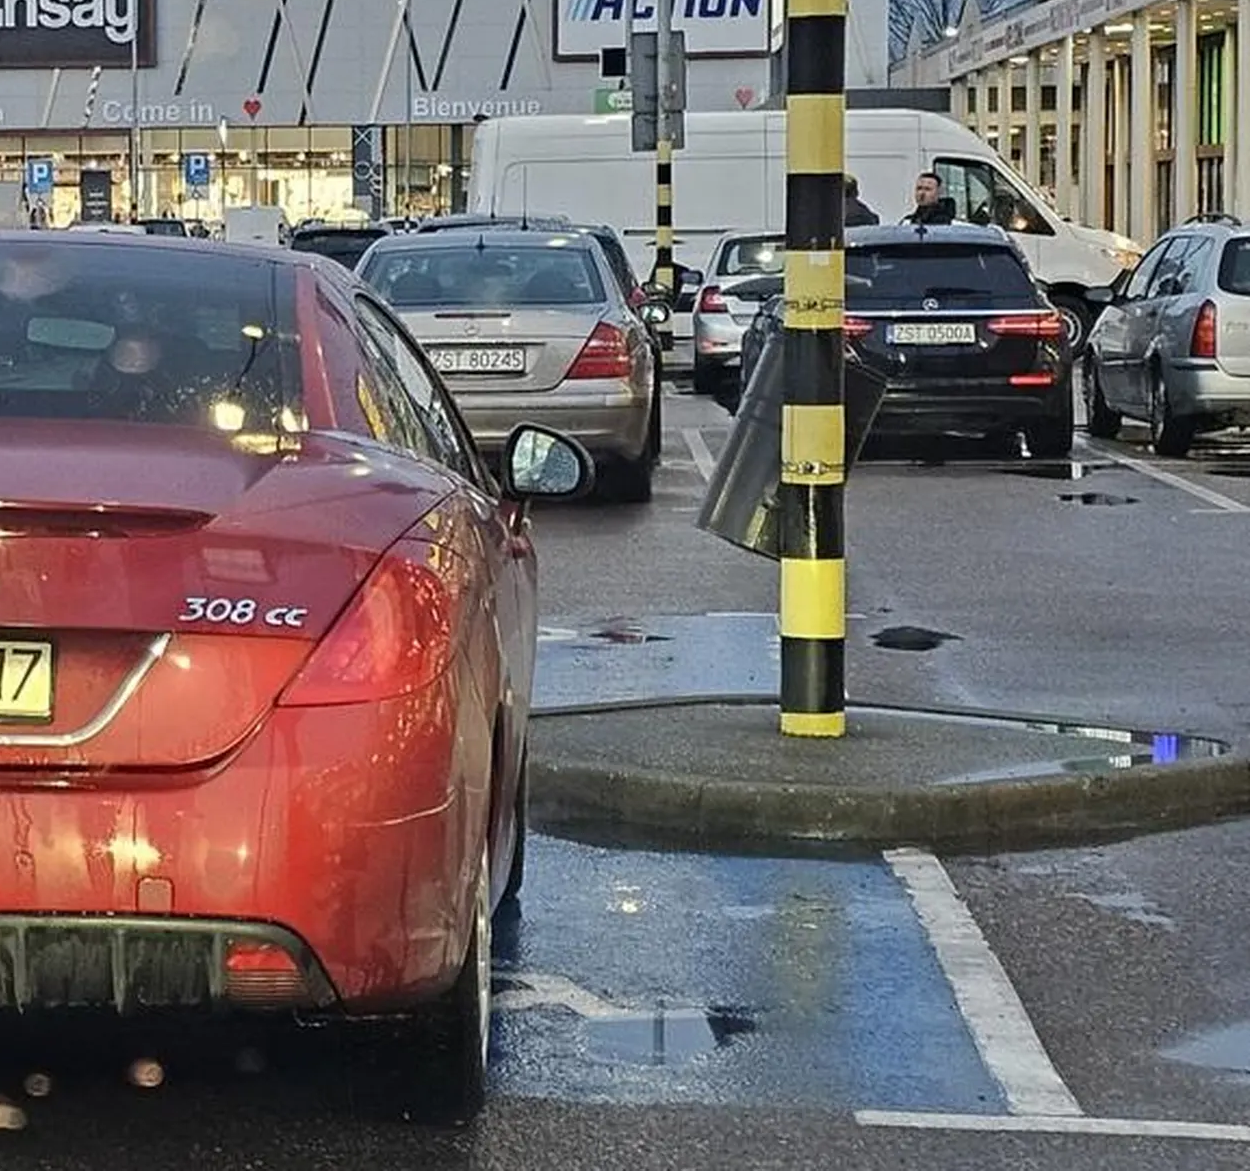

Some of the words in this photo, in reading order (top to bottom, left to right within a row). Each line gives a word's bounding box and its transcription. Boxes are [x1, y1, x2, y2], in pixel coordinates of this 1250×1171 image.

[102, 100, 180, 123] Come
[190, 97, 214, 123] in
[412, 96, 541, 117] Bienvenue
[33, 164, 49, 184] P
[190, 155, 205, 175] P
[178, 597, 256, 624] 308
